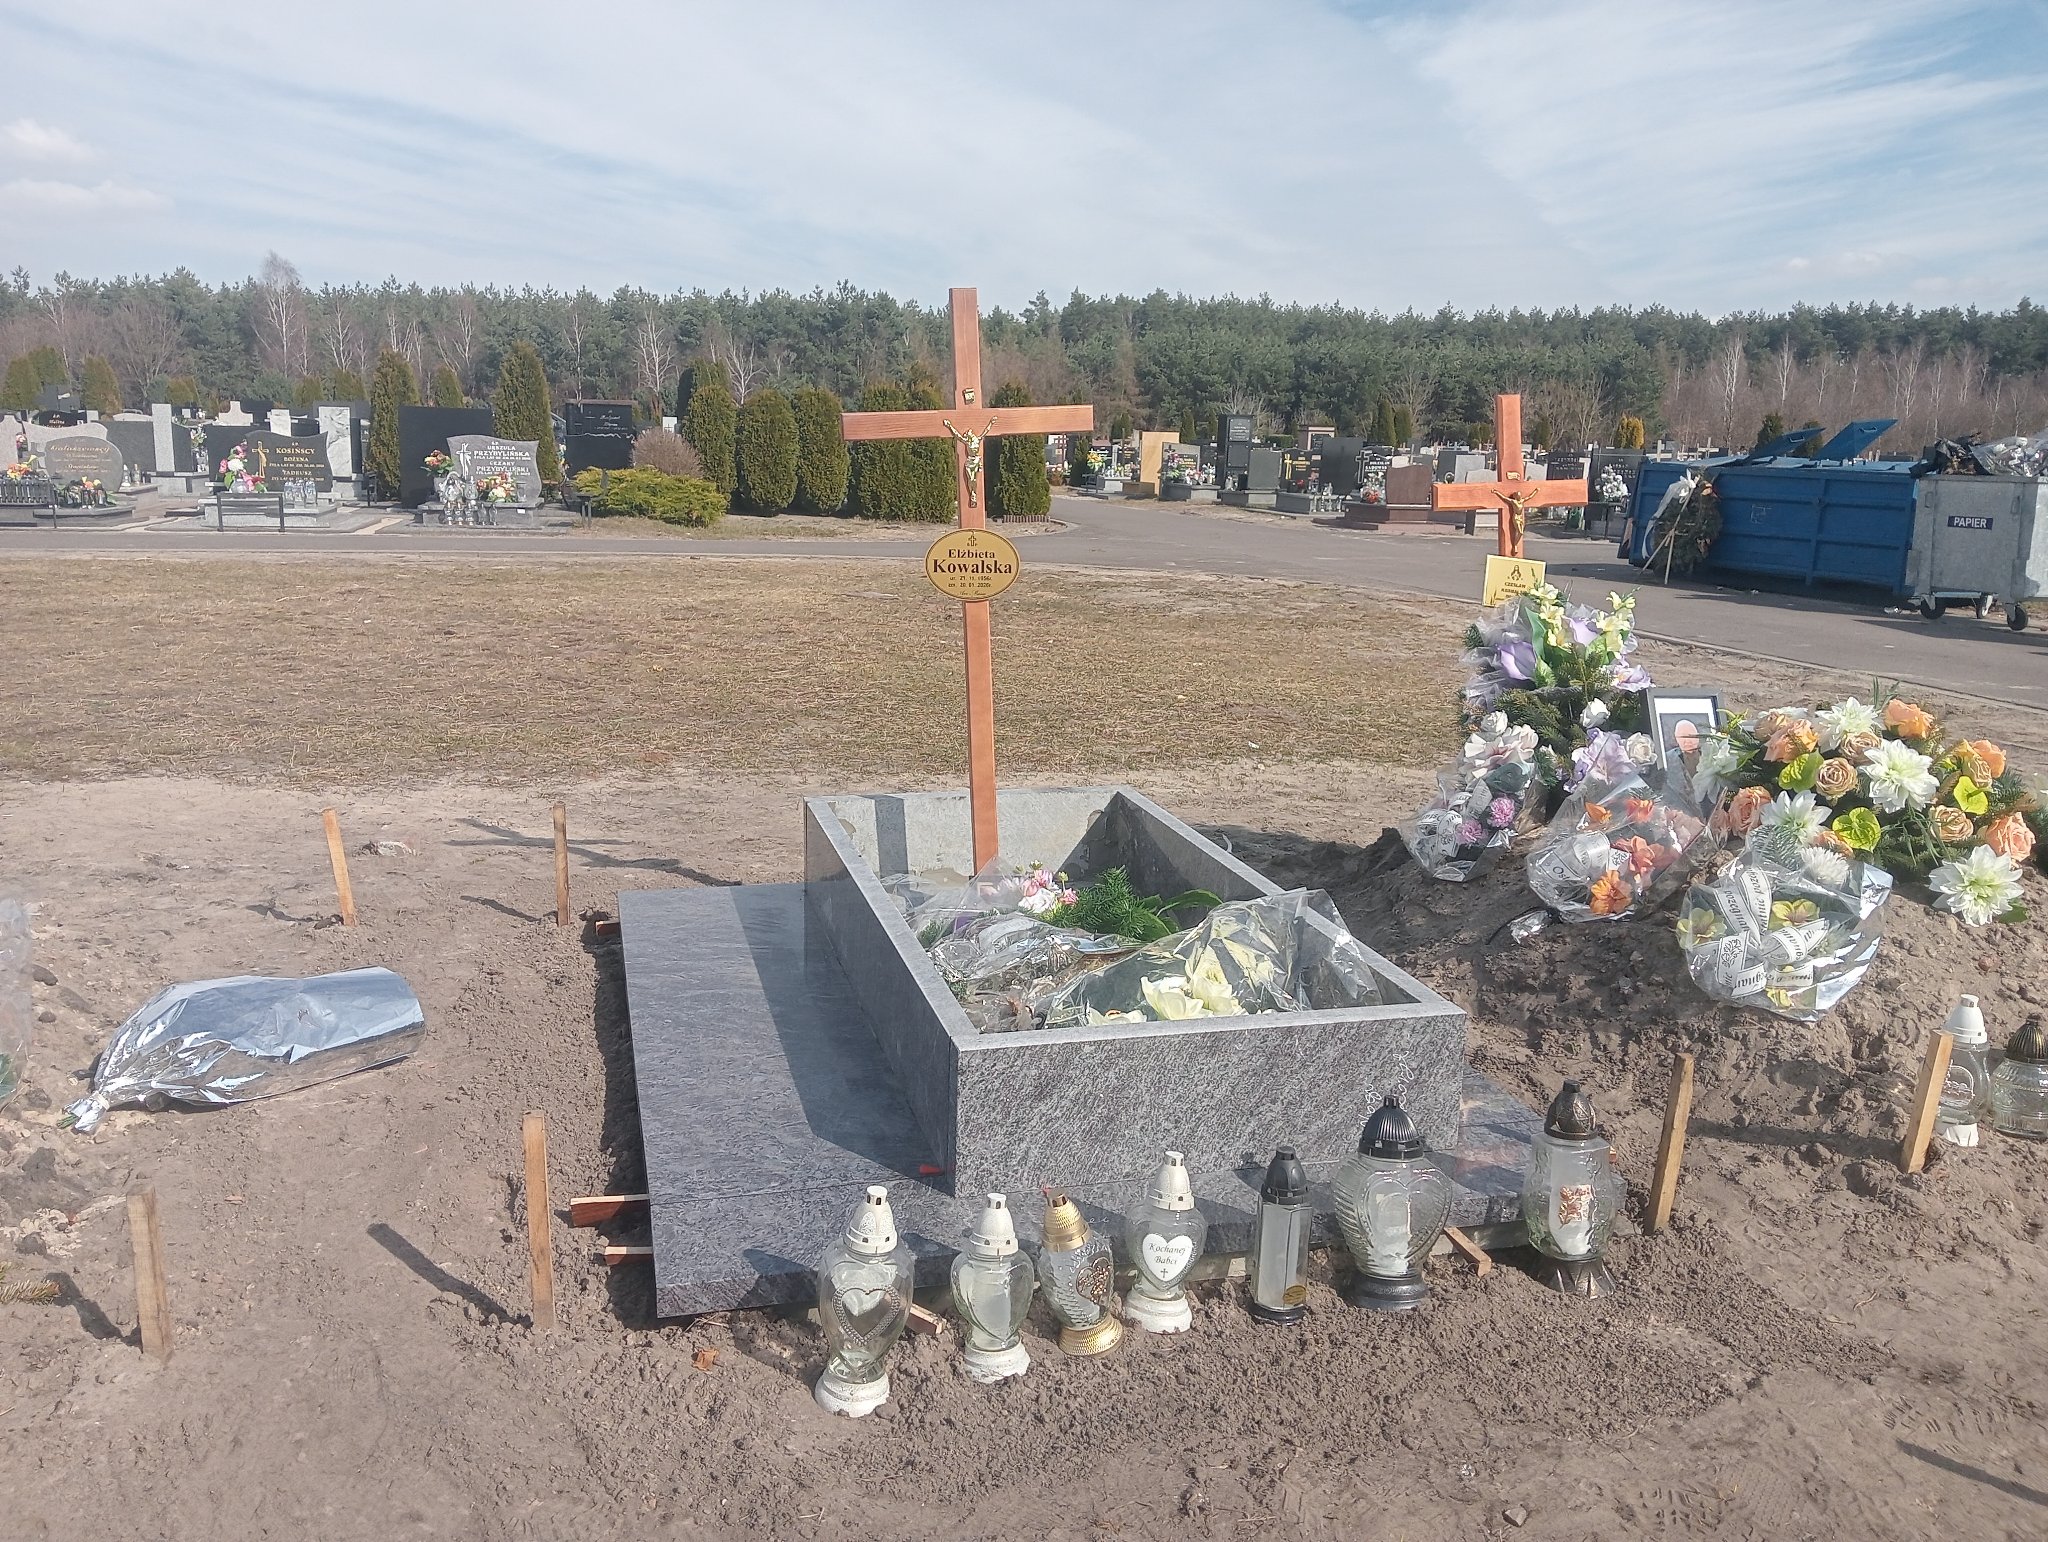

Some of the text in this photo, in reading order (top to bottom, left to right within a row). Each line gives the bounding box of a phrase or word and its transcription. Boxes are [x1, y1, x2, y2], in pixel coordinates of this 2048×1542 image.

[276, 447, 315, 455] KOSIŃSCY
[1953, 516, 1988, 529] PAPIER
[932, 558, 1012, 574] Kowalska
[1149, 1242, 1186, 1257] Kochanej
[1154, 1255, 1178, 1265] Babci
